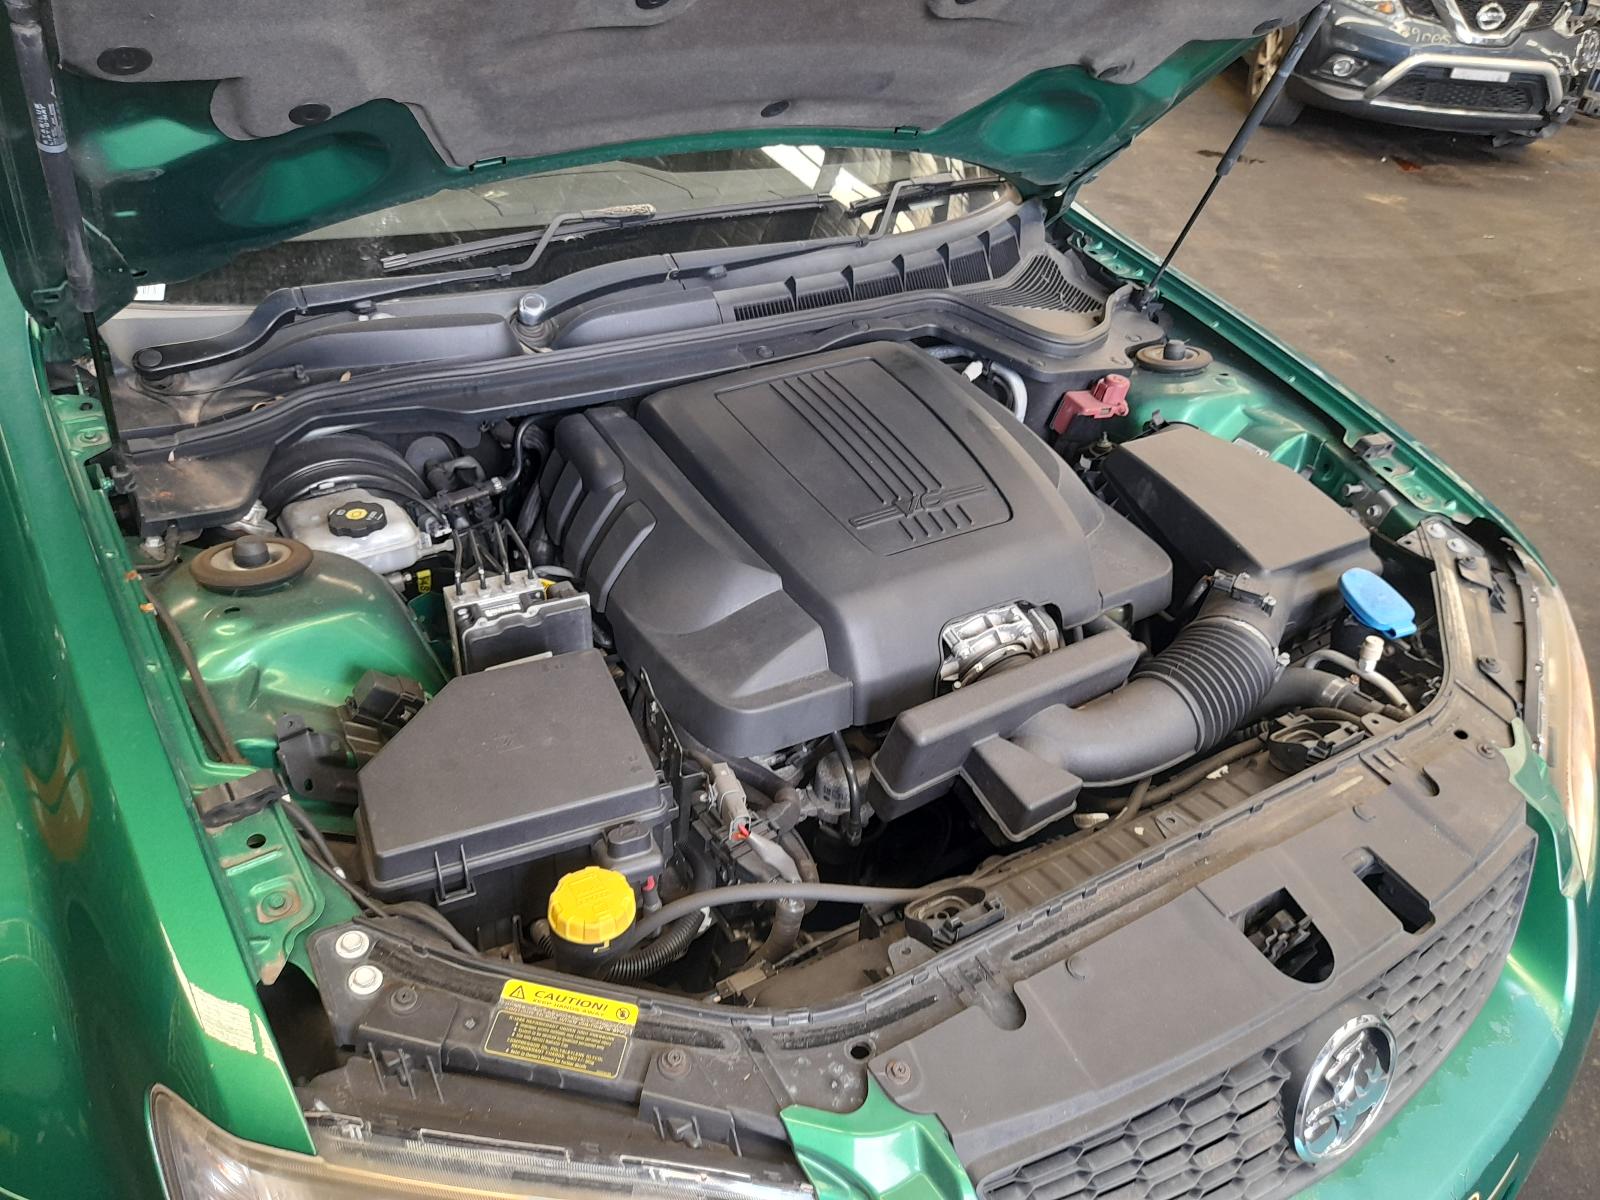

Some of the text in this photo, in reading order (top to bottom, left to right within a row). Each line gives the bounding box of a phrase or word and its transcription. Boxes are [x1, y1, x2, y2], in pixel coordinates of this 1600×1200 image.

[534, 990, 609, 1012] CAUTION!
[554, 1002, 581, 1012] HANDS
[582, 1007, 606, 1017] AWAY
